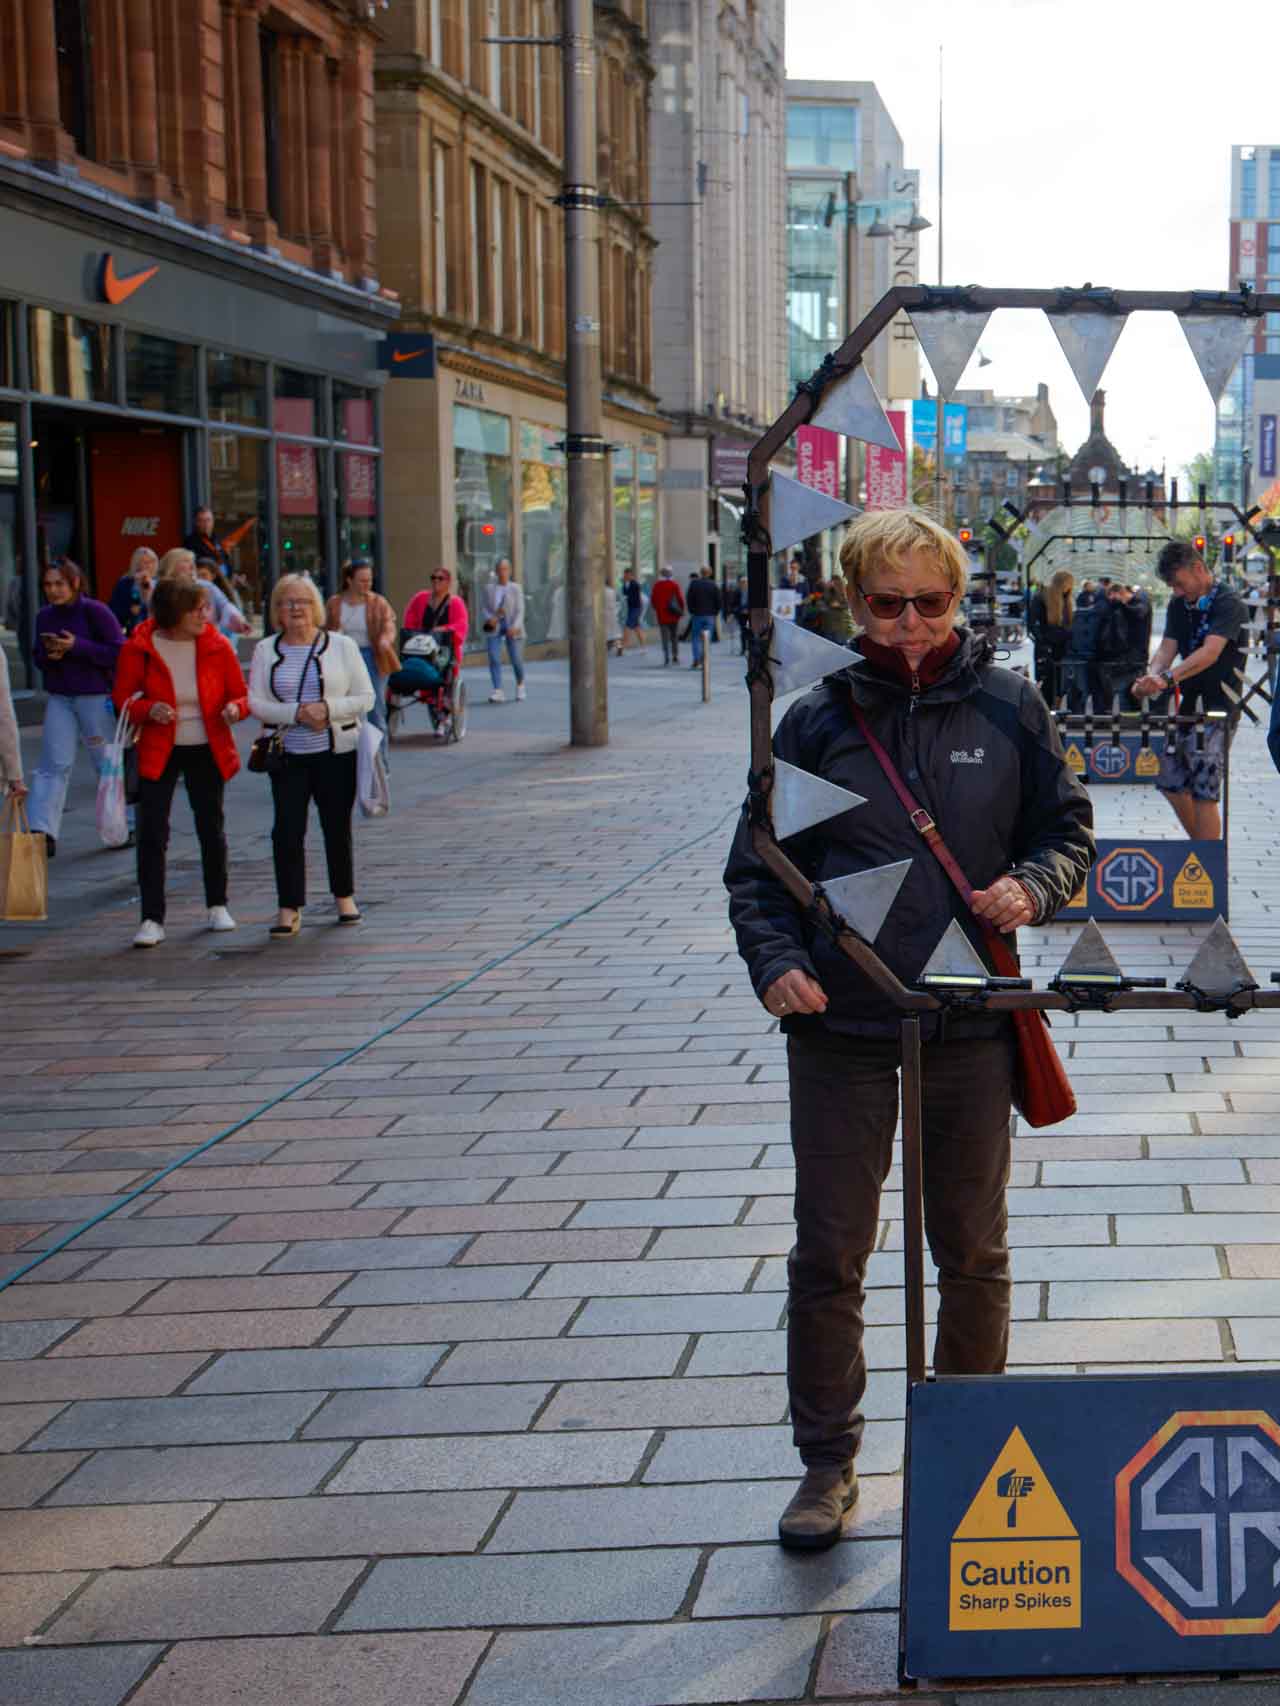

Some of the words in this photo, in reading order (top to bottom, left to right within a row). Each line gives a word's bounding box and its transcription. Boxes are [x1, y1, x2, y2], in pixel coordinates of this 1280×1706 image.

[960, 1560, 1071, 1586] Caution
[959, 1594, 1009, 1612] Sharp
[1015, 1592, 1072, 1611] Spikes
